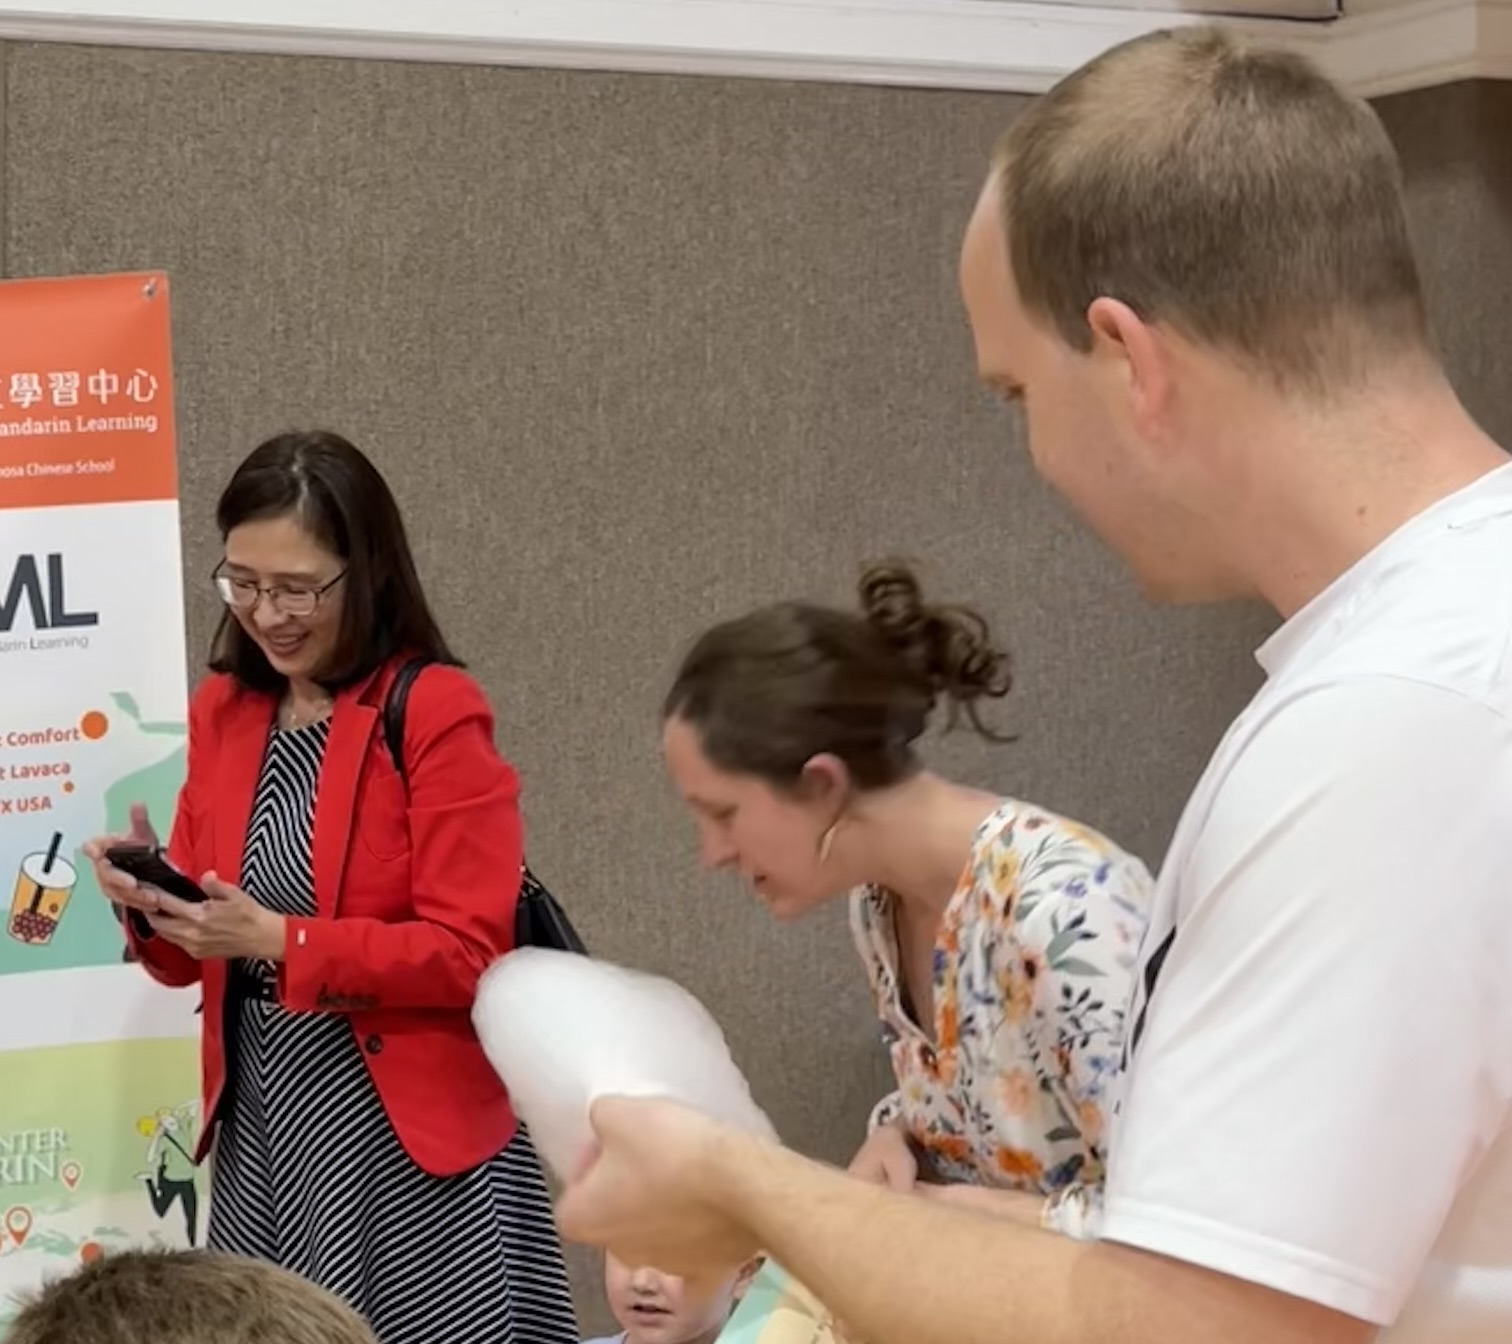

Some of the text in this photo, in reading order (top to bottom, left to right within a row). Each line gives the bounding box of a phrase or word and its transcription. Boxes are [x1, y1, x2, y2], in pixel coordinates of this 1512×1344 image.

[76, 413, 158, 433] Learning
[26, 461, 74, 476] Chinese
[76, 458, 115, 474] School
[30, 635, 89, 650] Learning
[6, 728, 80, 747] Comfort
[10, 763, 71, 779] Lavaca
[17, 796, 52, 813] USA
